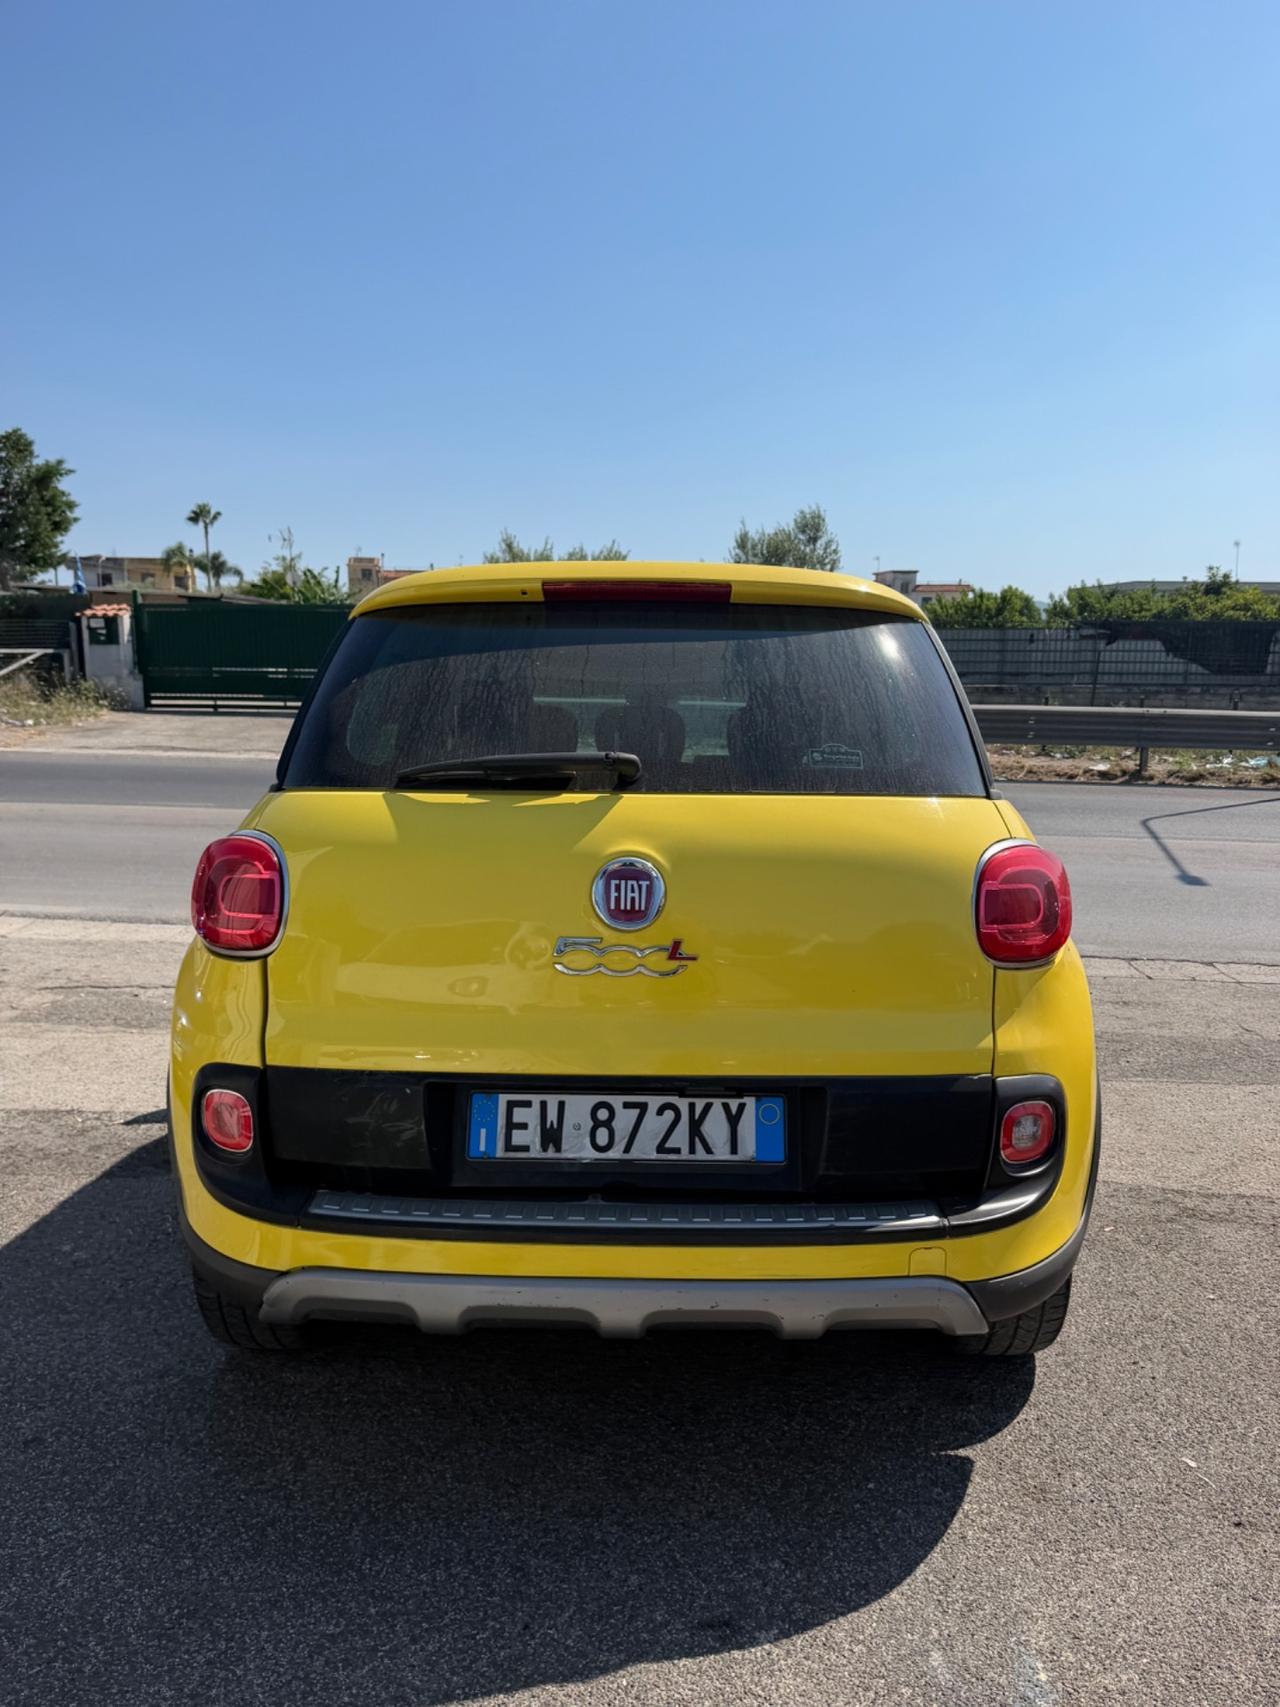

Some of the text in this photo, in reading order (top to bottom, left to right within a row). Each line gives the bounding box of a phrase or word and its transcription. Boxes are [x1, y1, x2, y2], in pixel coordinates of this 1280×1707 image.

[610, 879, 650, 911] FIAT
[479, 1127, 487, 1152] I
[503, 1099, 748, 1156] EW 872KY
